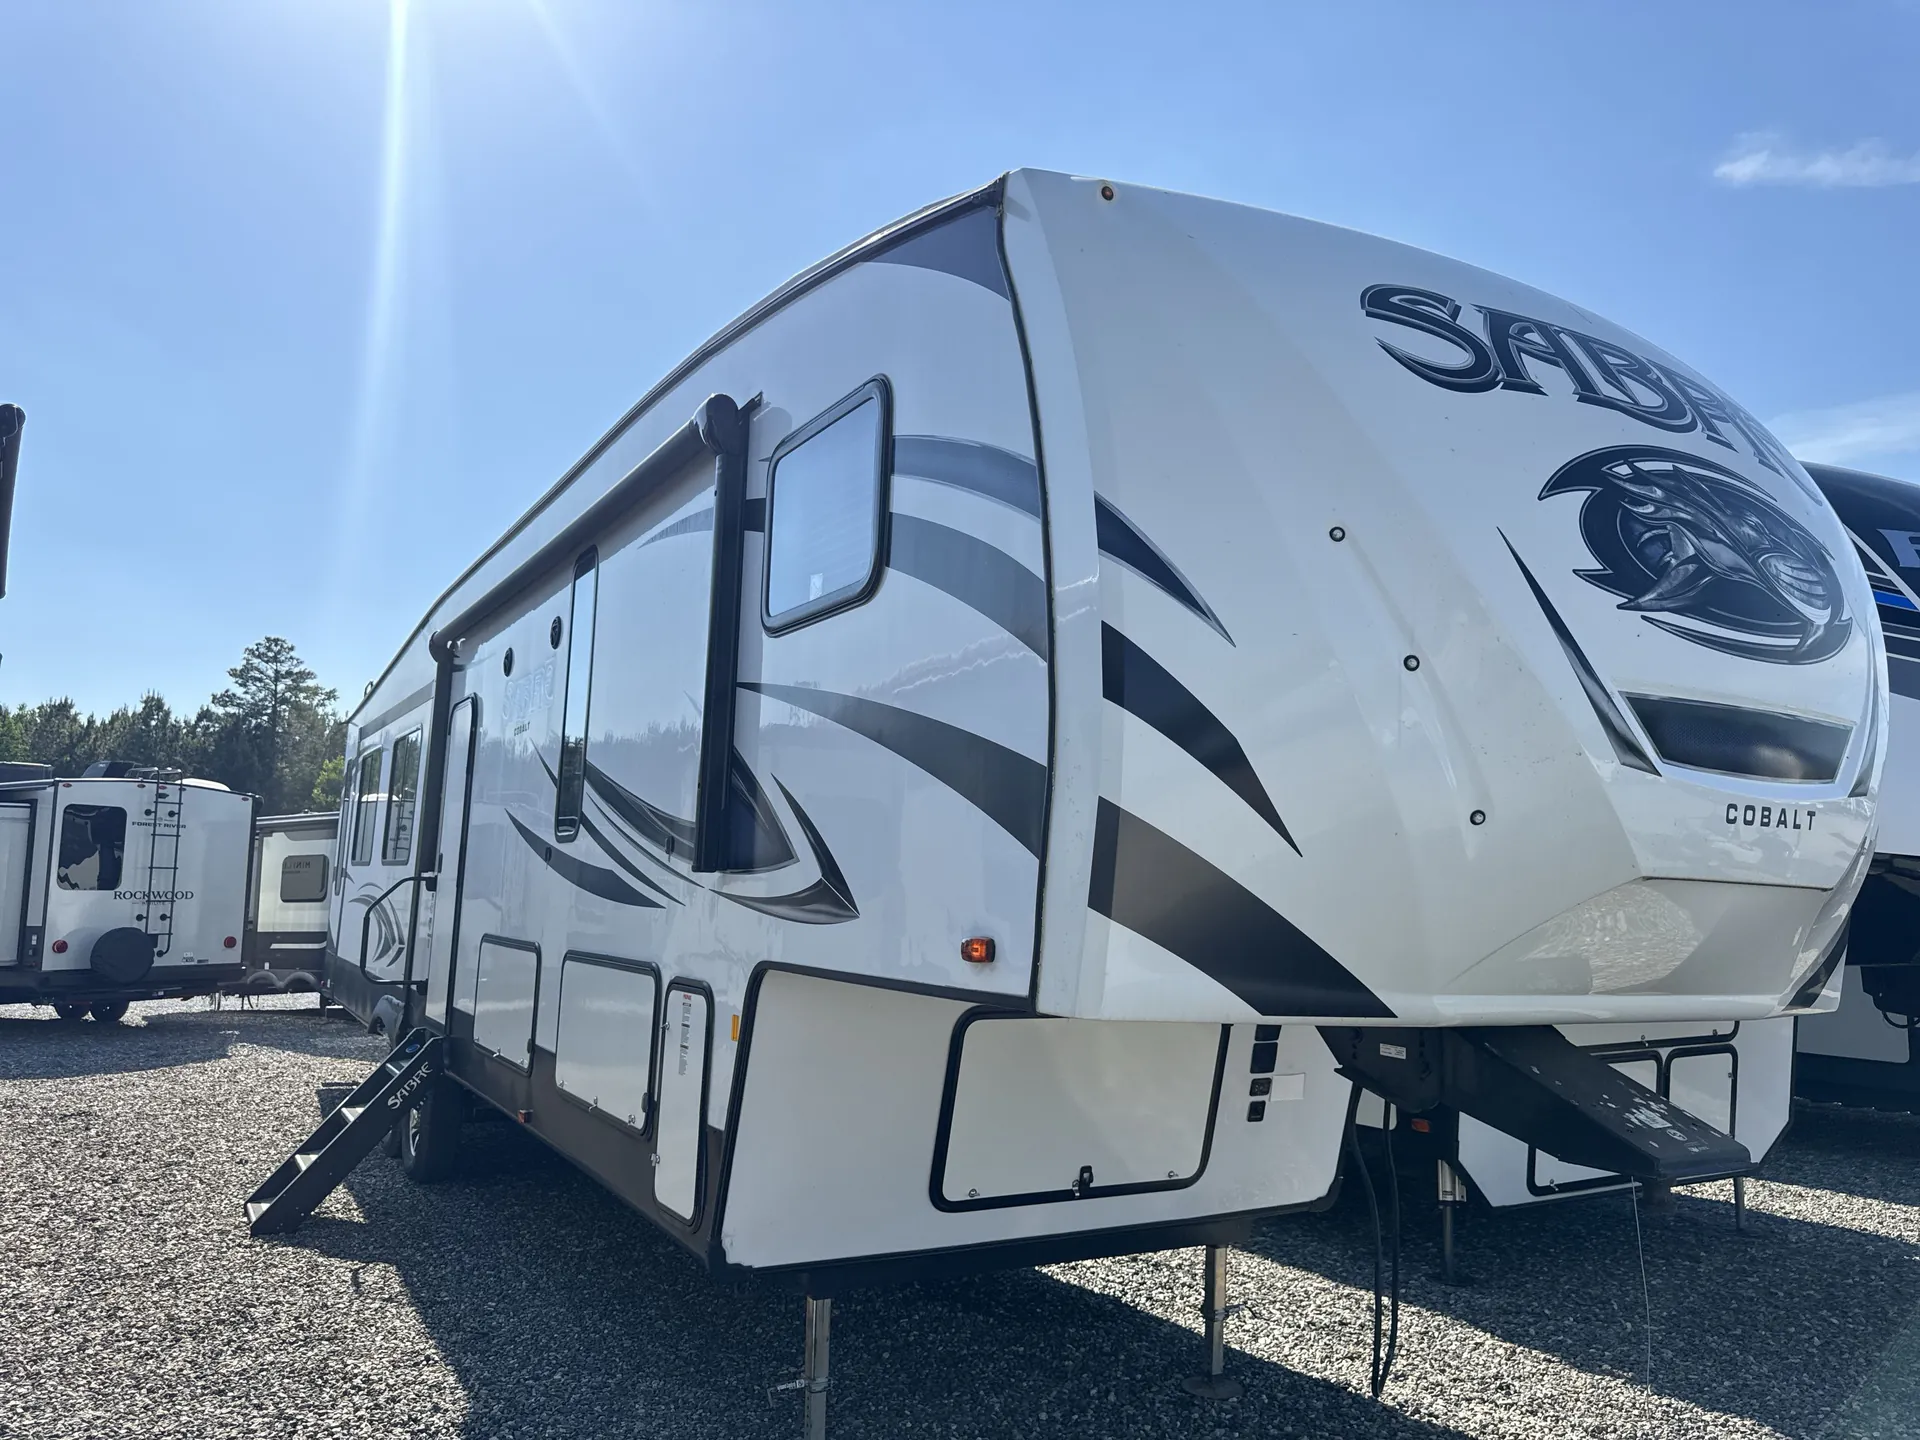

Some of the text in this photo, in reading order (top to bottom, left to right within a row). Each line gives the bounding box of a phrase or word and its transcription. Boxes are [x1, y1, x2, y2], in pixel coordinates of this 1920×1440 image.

[1725, 803, 1816, 831] COBALT
[113, 890, 194, 900] ROCKWOOD
[387, 1061, 433, 1110] SABRE
